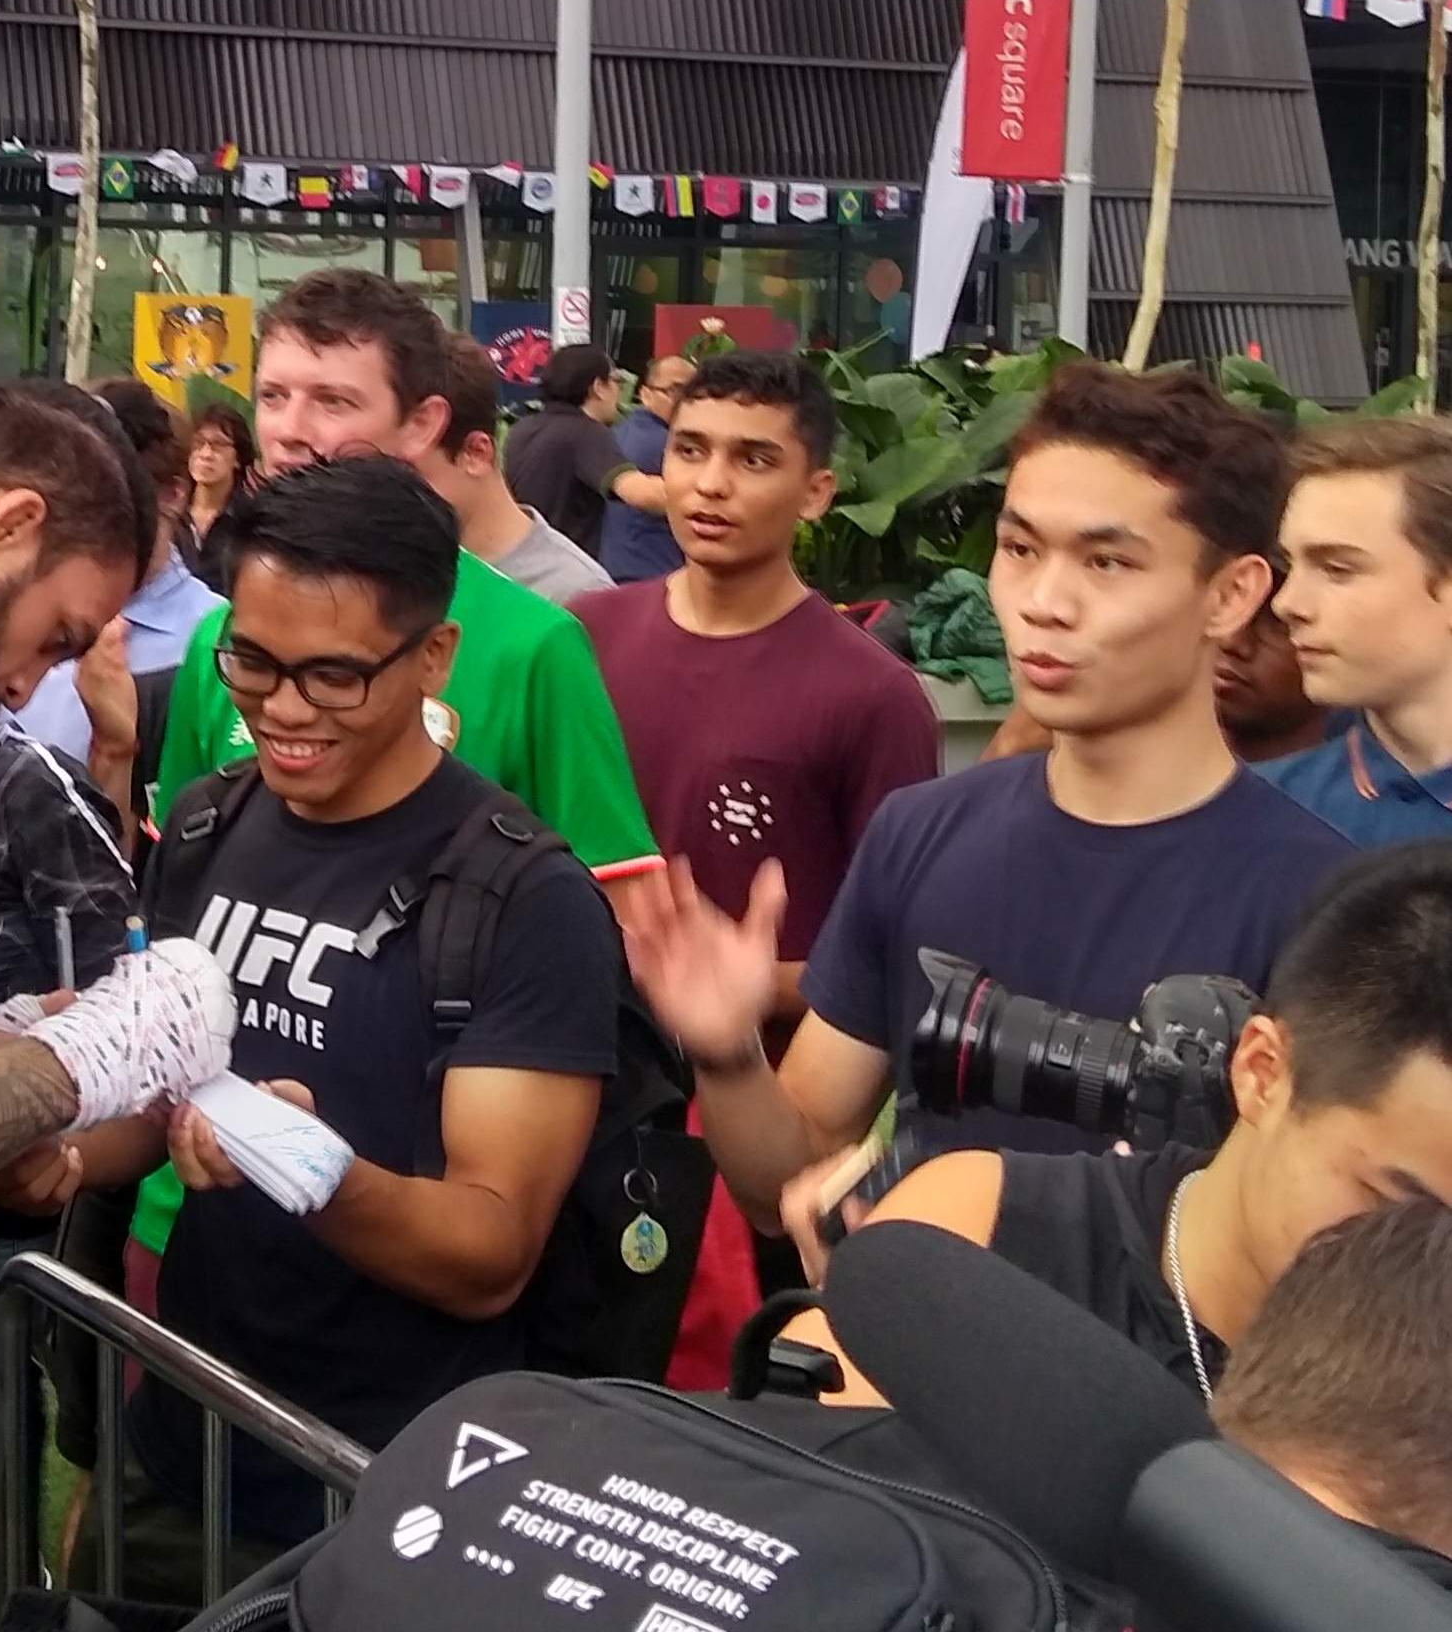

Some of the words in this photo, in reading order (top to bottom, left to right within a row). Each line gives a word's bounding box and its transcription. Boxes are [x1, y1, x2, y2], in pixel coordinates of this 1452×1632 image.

[995, 21, 1028, 141] square
[1344, 238, 1401, 268] ANG
[195, 894, 359, 1008] UFC
[239, 997, 325, 1050] APORE
[500, 1504, 577, 1548] FIGHT
[575, 1534, 645, 1578] CONT.
[648, 1562, 749, 1620] ORIGIN:
[523, 1480, 643, 1537] STRENGTH
[637, 1520, 777, 1592] DISCIPLINE
[601, 1474, 688, 1520] HONOR
[682, 1506, 799, 1565] RESPECT
[546, 1574, 605, 1611] UFC
